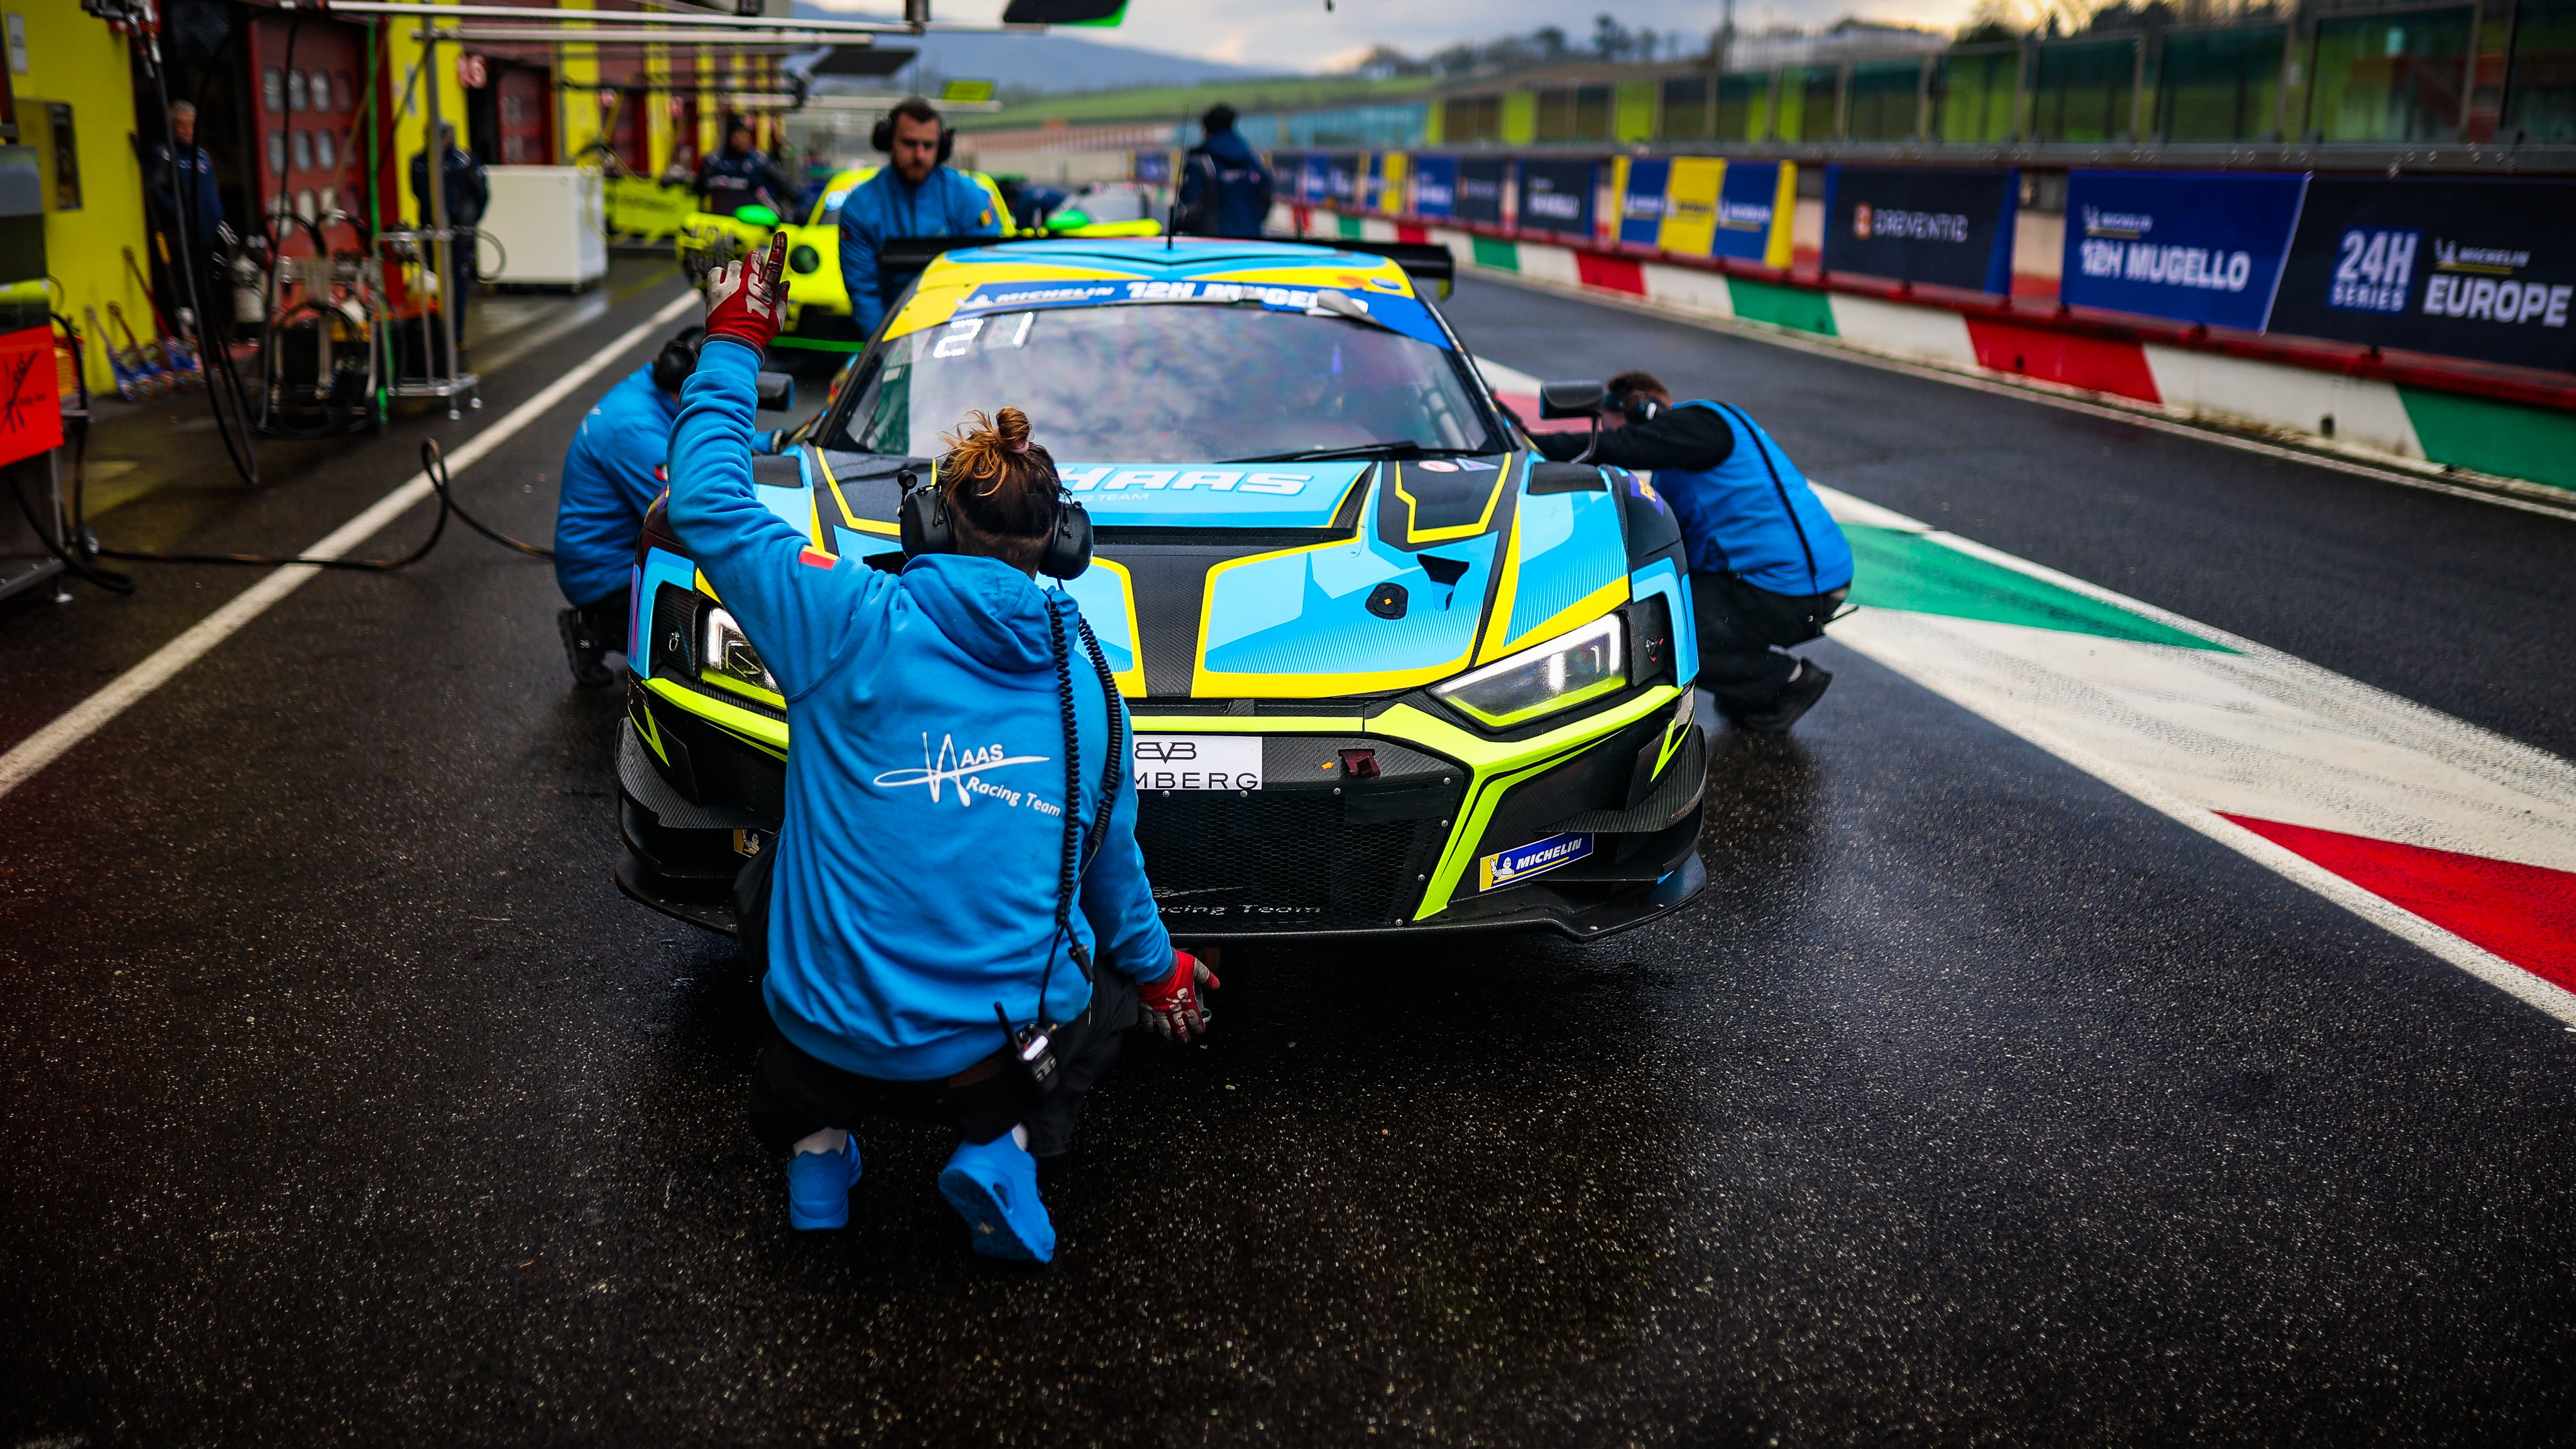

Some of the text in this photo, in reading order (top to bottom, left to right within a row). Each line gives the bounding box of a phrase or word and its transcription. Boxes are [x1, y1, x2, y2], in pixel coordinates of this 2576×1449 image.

[2080, 238, 2252, 293] 12H MUGELLO
[2337, 230, 2419, 287] 24H
[2457, 246, 2531, 268] MICHELIN
[995, 287, 1116, 303] MICHELIN
[1127, 282, 1196, 299] 12H
[2331, 280, 2406, 312] SERIES
[2421, 273, 2574, 328] EUROPE
[932, 312, 1035, 358] 21
[1054, 467, 1314, 495] HAAS
[1098, 493, 1150, 501] TEAM
[966, 776, 1062, 817] Racing Team
[1134, 772, 1258, 790] MBERG
[1515, 838, 1583, 870] MICHELIN
